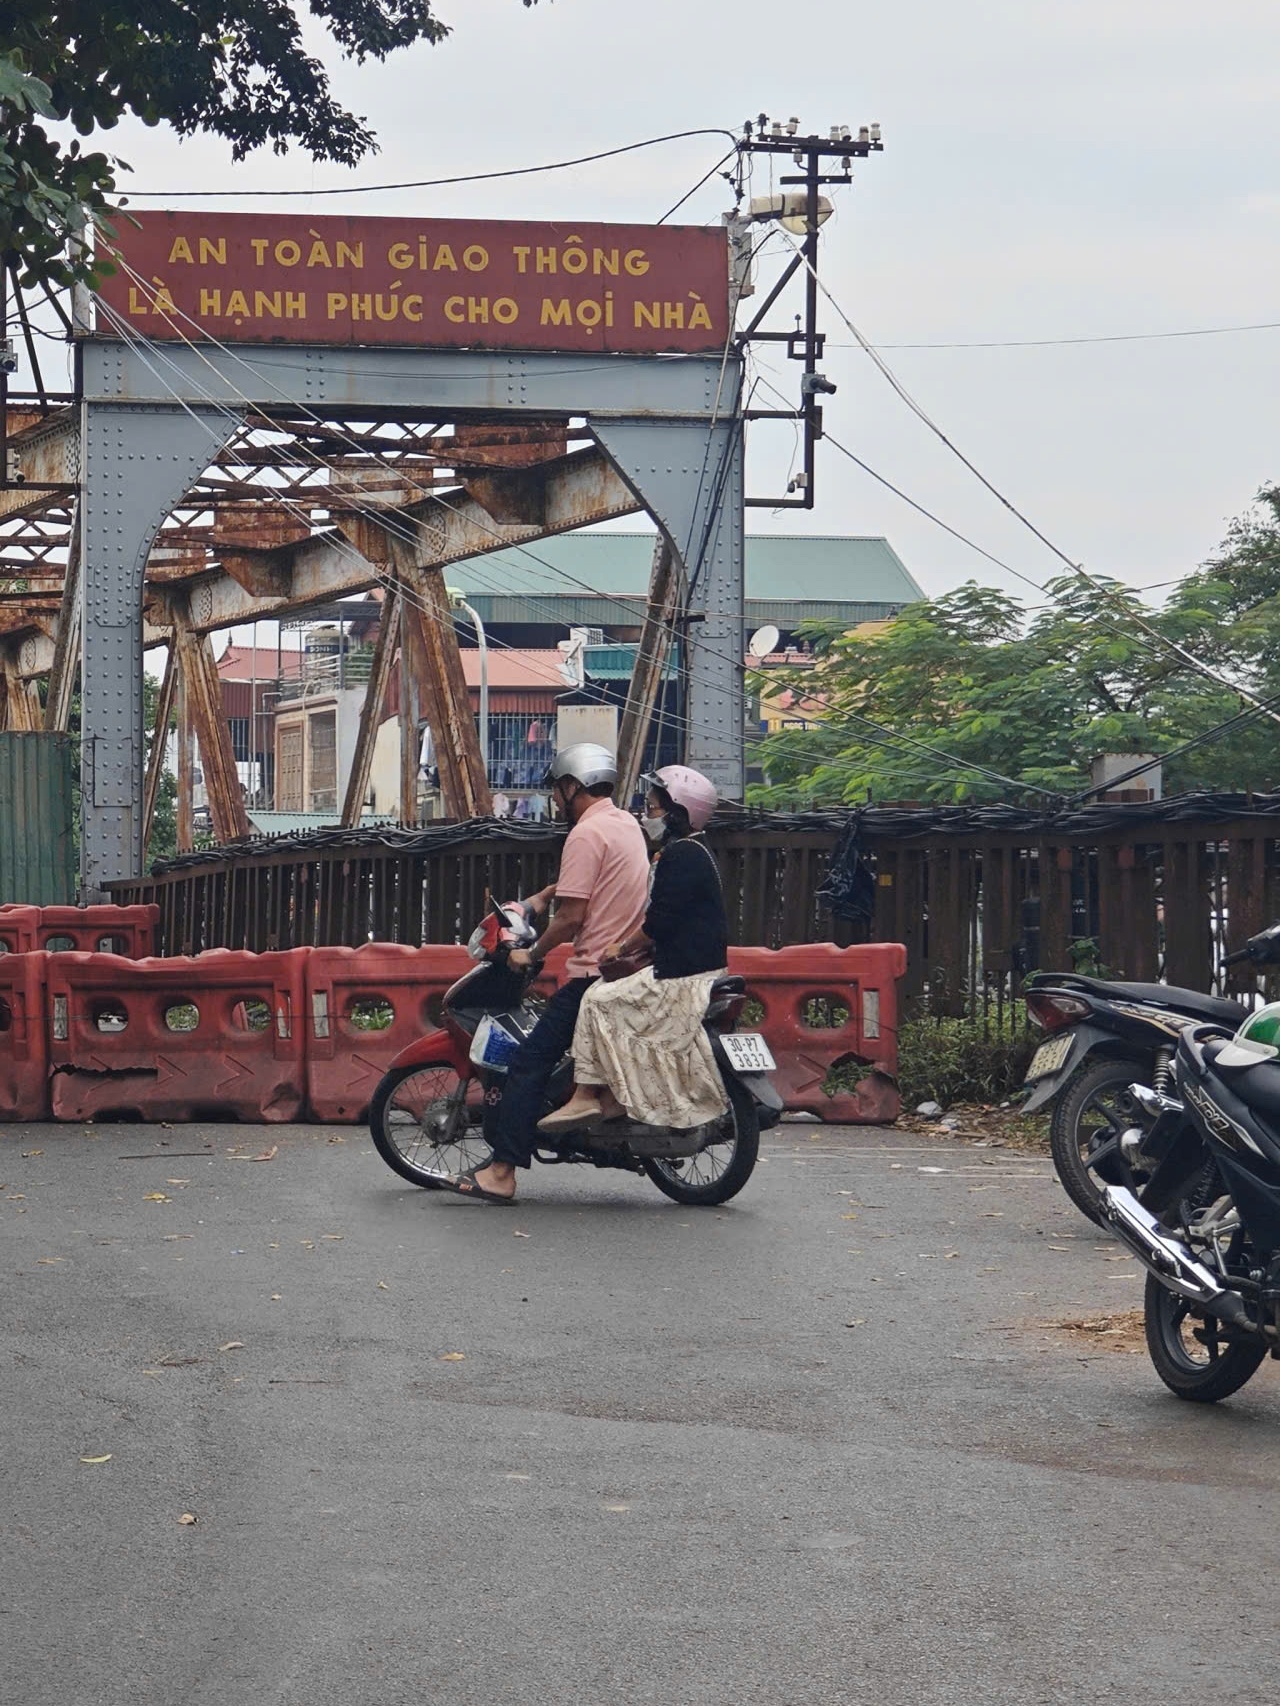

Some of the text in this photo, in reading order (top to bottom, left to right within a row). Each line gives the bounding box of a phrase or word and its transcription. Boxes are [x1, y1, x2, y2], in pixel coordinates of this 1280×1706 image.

[168, 236, 227, 264] AN
[251, 229, 364, 269] TOÀN
[513, 235, 650, 276] THÔNG
[129, 276, 178, 315] LÀ
[200, 288, 307, 326] HẠNH
[327, 280, 424, 321] PHÚC
[444, 296, 519, 324] CHO
[634, 291, 713, 330] NHÀ
[727, 1037, 759, 1052] 30-P7
[735, 1053, 769, 1068] 3832
